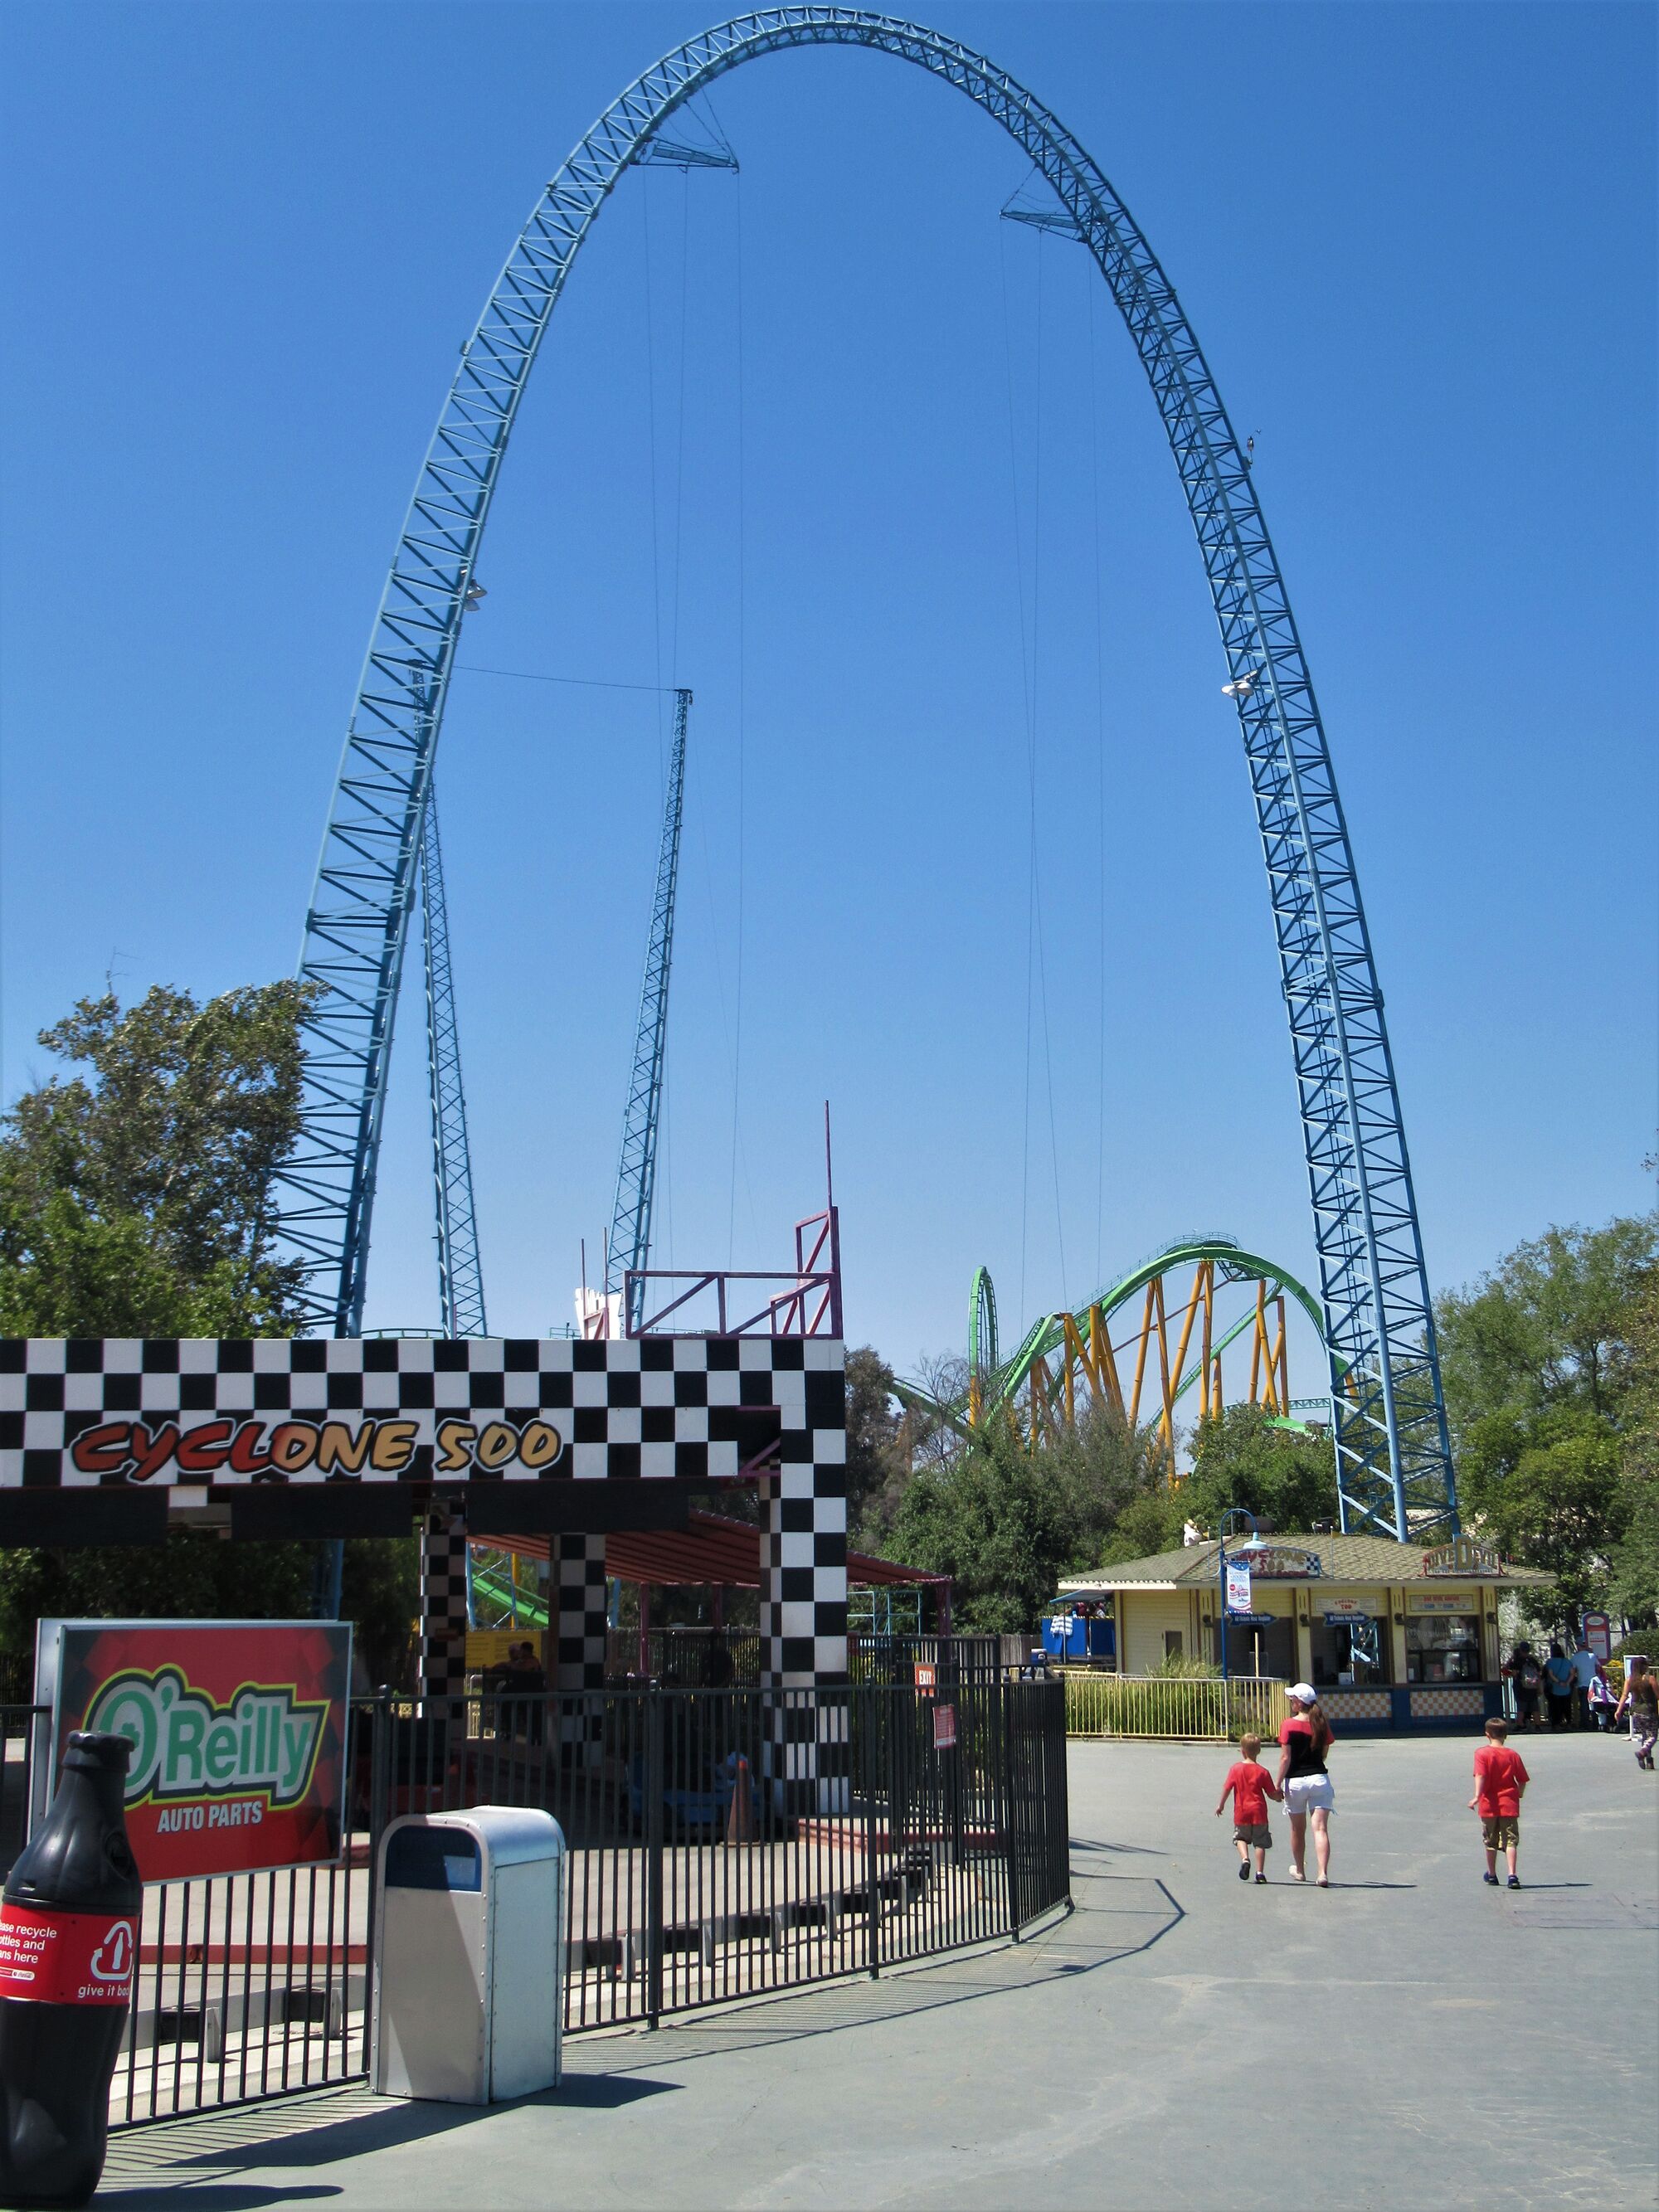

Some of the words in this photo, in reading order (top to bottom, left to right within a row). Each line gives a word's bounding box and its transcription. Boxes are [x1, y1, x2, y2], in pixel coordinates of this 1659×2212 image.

[73, 1420, 419, 1481] CYCLONE
[432, 1419, 562, 1472] 500
[919, 1670, 932, 1685] EXIT
[99, 1685, 313, 1789] O'Reilly
[157, 1805, 204, 1833] AUTO
[208, 1801, 263, 1829] PARTS
[16, 1925, 57, 1938] recycle
[0, 1934, 21, 1947] ottles
[22, 1940, 46, 1951] and
[0, 1950, 12, 1960] ans
[13, 1949, 39, 1964] here
[78, 1984, 105, 1998] give
[107, 1984, 115, 1996] it
